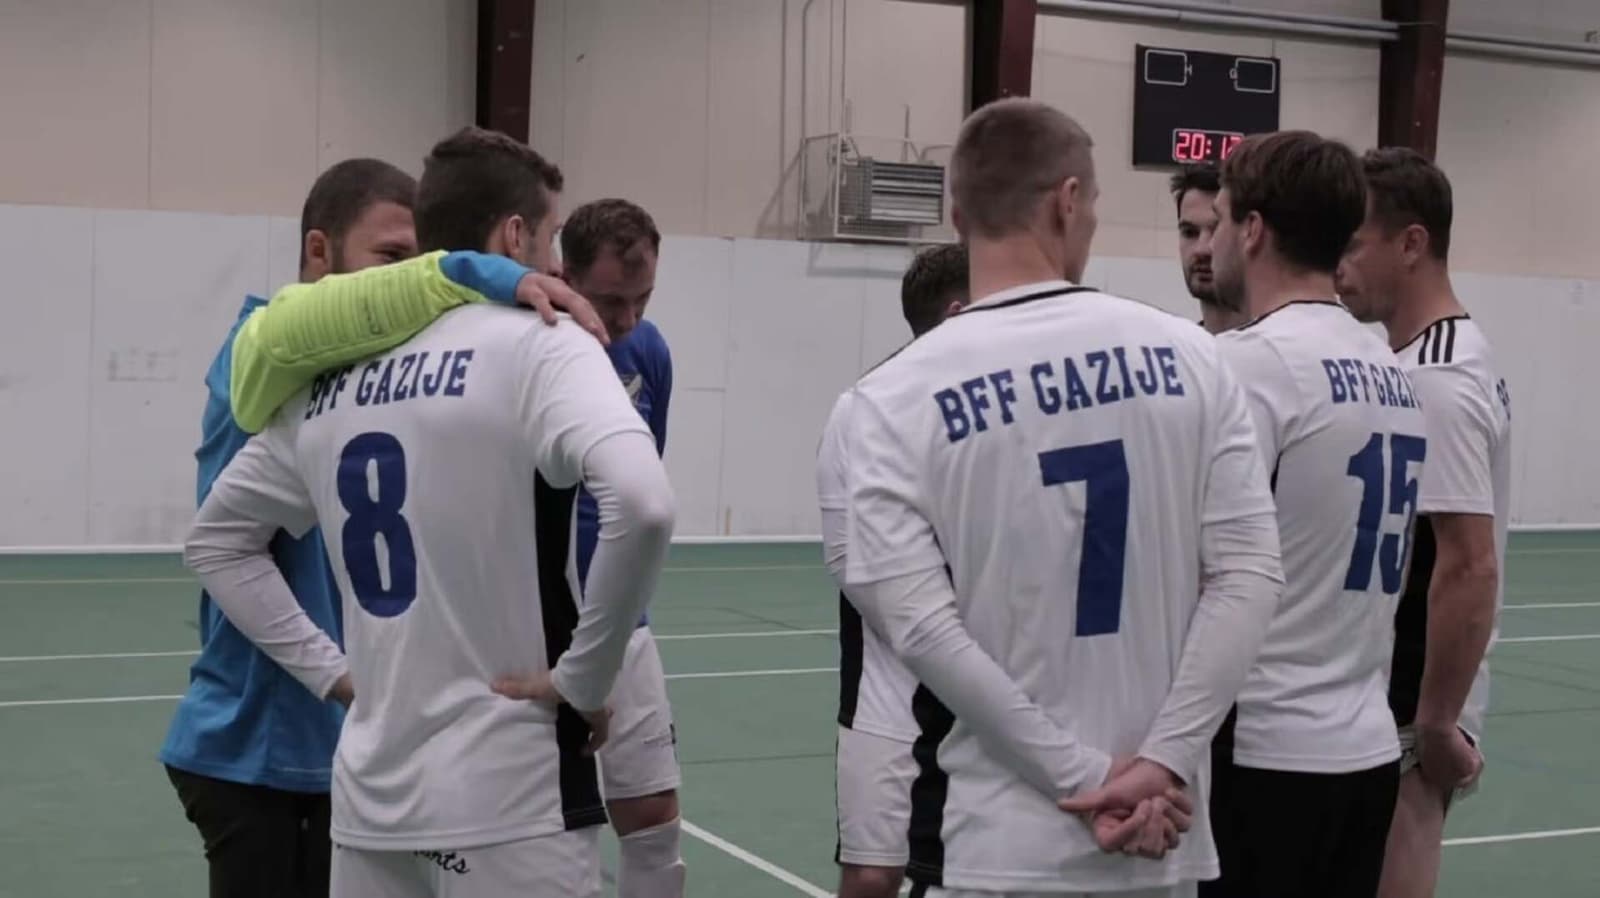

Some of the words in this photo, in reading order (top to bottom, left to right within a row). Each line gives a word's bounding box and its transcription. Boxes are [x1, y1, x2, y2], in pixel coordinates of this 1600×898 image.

[355, 349, 475, 407] GAZIJE
[934, 369, 1018, 443] BFF
[1029, 346, 1185, 416] GAZIJE
[1321, 358, 1370, 404] BFF
[1368, 363, 1423, 411] GAZI
[337, 431, 418, 619] 8
[1037, 438, 1130, 638] 7
[1343, 432, 1427, 594] 15
